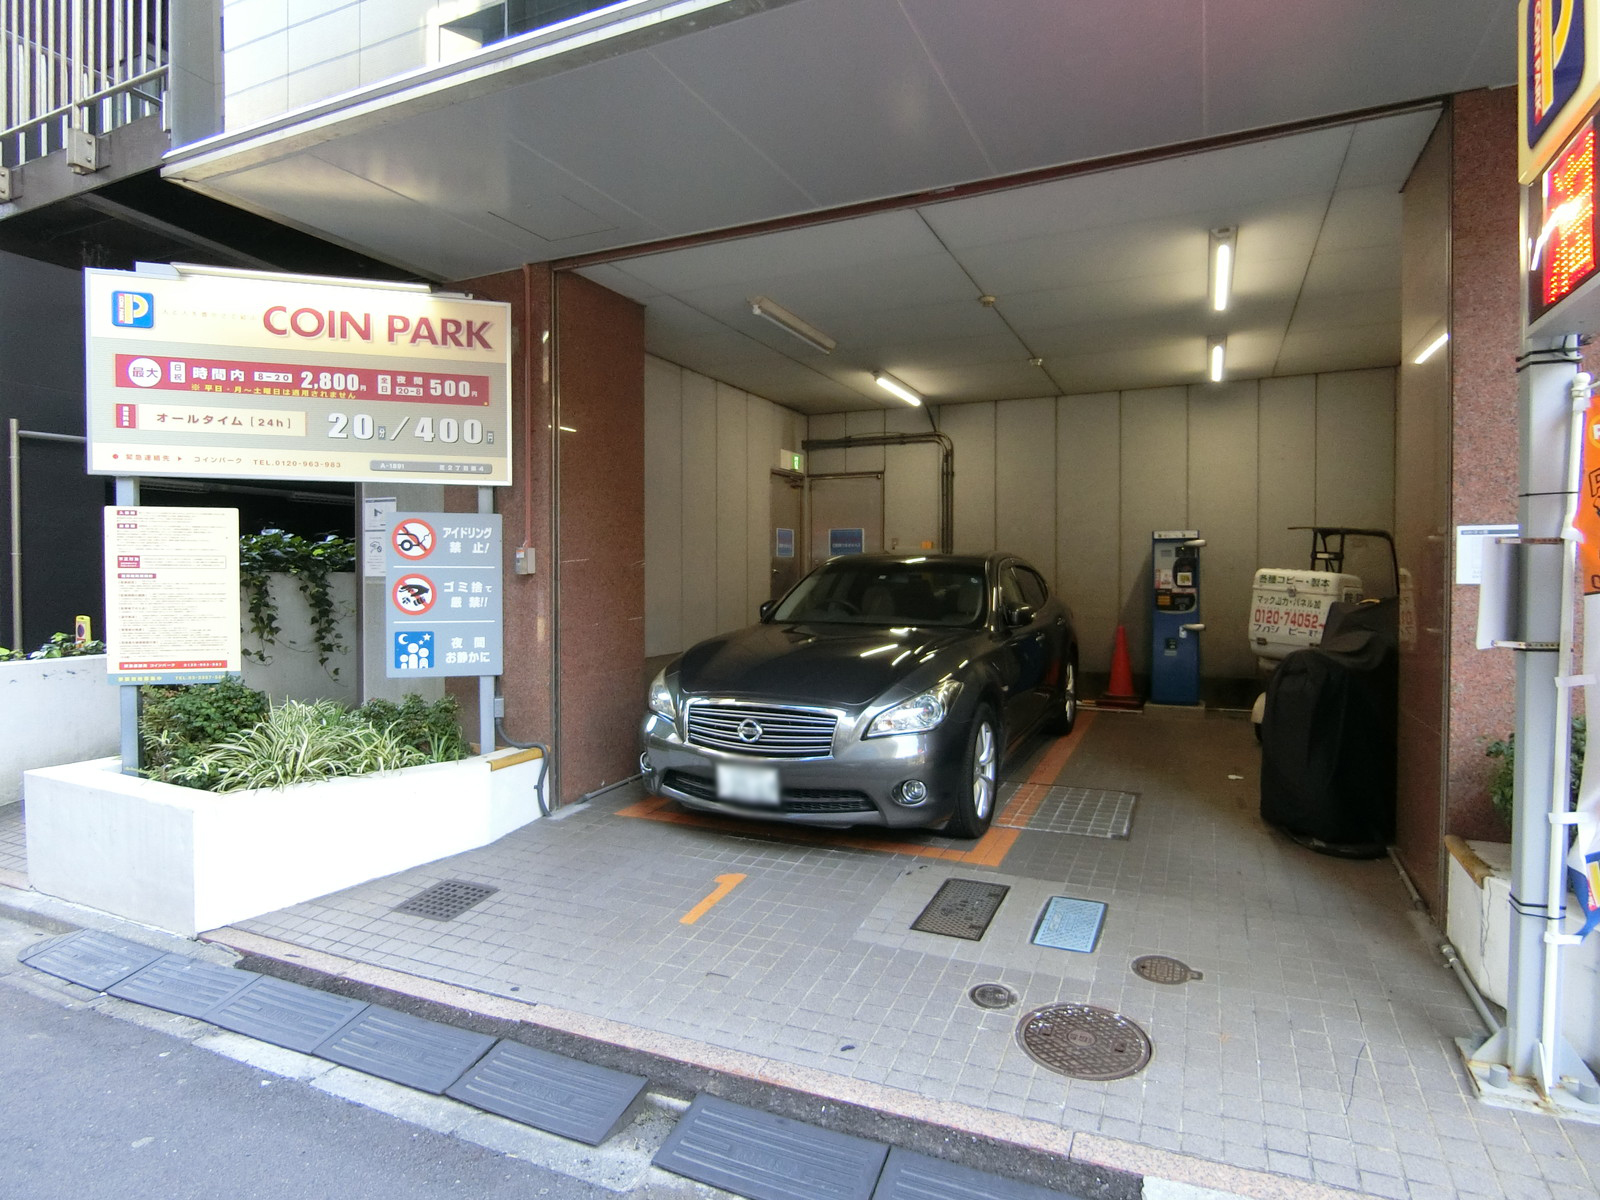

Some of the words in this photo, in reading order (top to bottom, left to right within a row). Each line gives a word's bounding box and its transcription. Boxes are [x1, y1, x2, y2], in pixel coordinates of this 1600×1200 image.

[263, 306, 370, 341] COIN
[387, 315, 493, 350] PARK
[131, 366, 159, 379] 最大
[191, 366, 245, 382] 時間内
[257, 372, 291, 382] 8-20
[156, 413, 243, 427] オールタイム
[443, 527, 493, 540] アイドリング
[443, 581, 493, 593] ゴミ捨て
[451, 636, 486, 649] 夜間
[445, 651, 491, 664] お静かに
